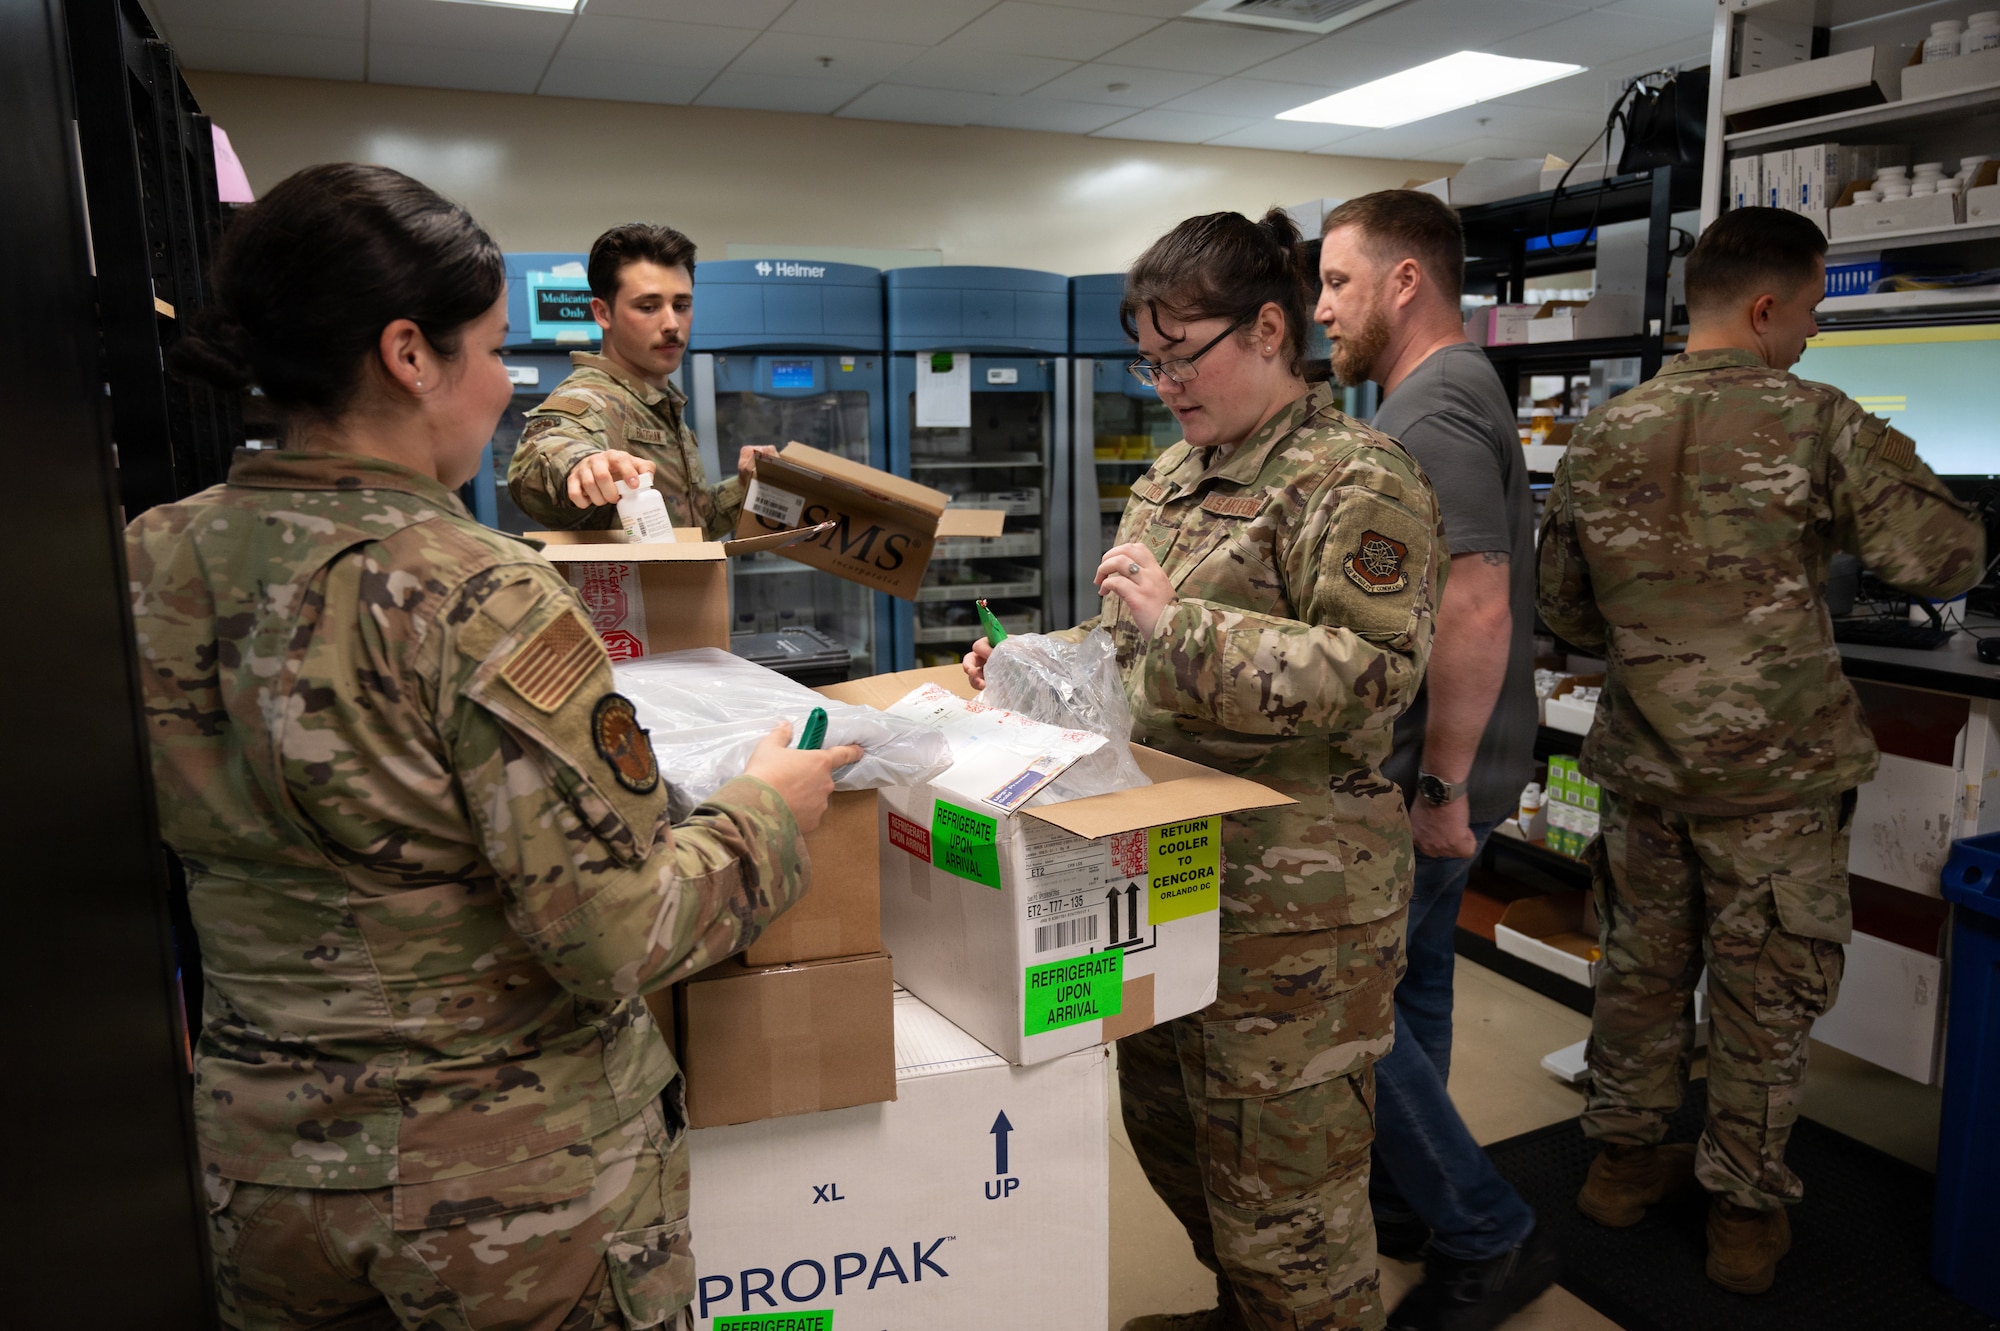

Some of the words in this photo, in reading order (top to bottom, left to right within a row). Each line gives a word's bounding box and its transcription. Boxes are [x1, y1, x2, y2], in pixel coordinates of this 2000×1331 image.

[775, 262, 826, 278] Helmer
[541, 292, 595, 304] Medicatio
[559, 306, 586, 319] Only
[755, 504, 922, 571] SMS®
[890, 815, 928, 843] REFRIGERATE
[937, 807, 992, 842] REFRIGERATE
[1161, 820, 1208, 838] RETURN
[891, 828, 906, 845] UPON
[905, 835, 929, 857] ARRIVAL
[949, 832, 973, 855] UPON
[1158, 836, 1208, 856] COOLER
[945, 851, 982, 877] ARRIVAL
[1177, 855, 1192, 866] TO
[1031, 867, 1045, 878] ET2
[1153, 866, 1214, 889] CENCORA
[1160, 885, 1198, 900] ORLANDO
[1200, 882, 1211, 891] DC
[1031, 956, 1117, 989] REFRIGERATE
[1057, 981, 1091, 1003] UPON
[1047, 999, 1099, 1025] ARRIVAL
[812, 1182, 845, 1204] XL
[985, 1177, 1020, 1200] UP
